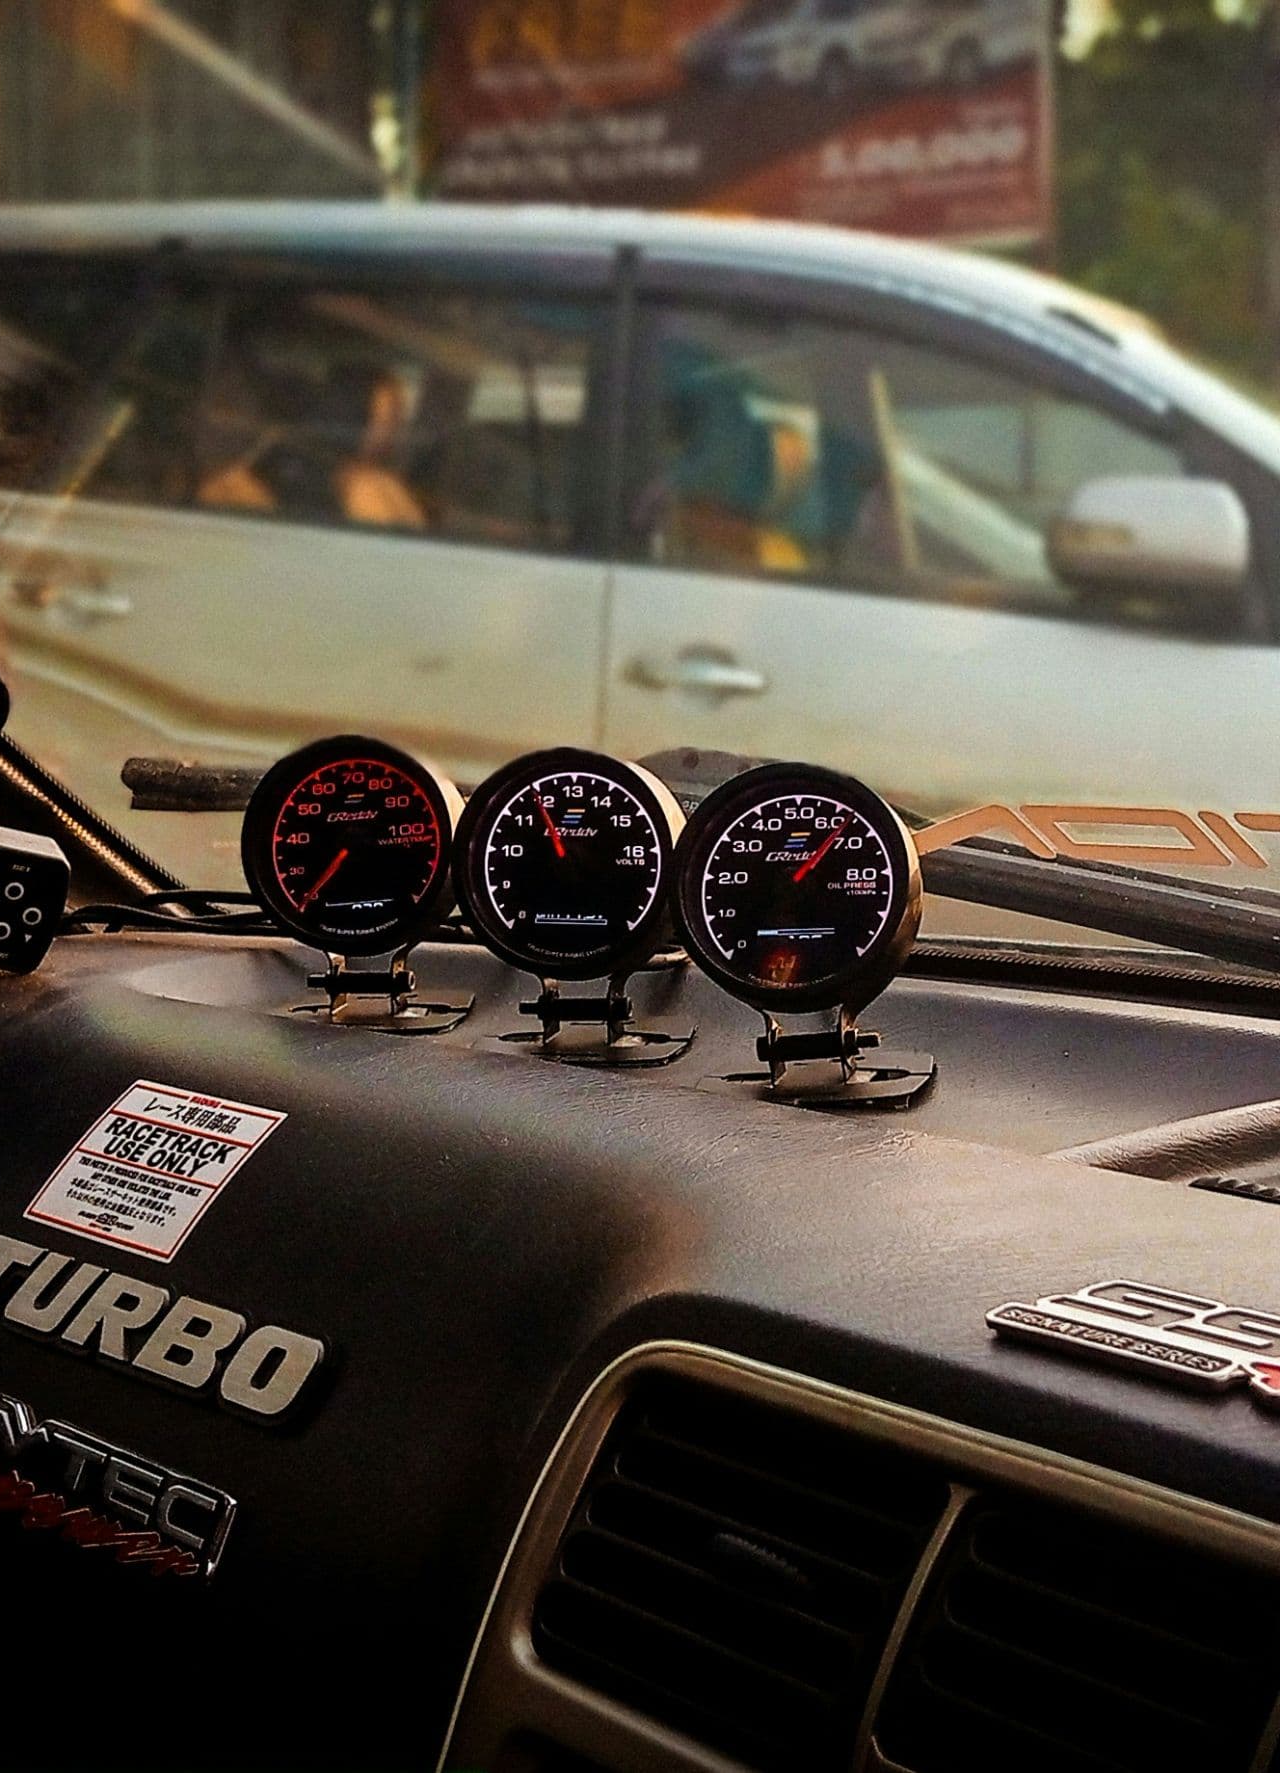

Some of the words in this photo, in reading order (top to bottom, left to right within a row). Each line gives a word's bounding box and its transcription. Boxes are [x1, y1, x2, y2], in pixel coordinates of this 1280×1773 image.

[342, 772, 364, 784] 70
[368, 778, 392, 790] 80
[312, 783, 336, 795] 60
[562, 786, 583, 798] 13
[385, 796, 410, 808] 90
[590, 796, 612, 808] 14
[297, 803, 321, 816] 50
[784, 807, 814, 819] 5.0
[514, 815, 533, 826] 11
[610, 815, 631, 827] 15
[752, 818, 782, 831] 4.0
[815, 817, 845, 829] 6.0
[388, 824, 425, 836] 100
[286, 832, 310, 845] 40
[833, 837, 863, 849] 7.0
[501, 845, 523, 857] 10
[623, 846, 644, 858] 16
[732, 840, 763, 853] 3.0
[289, 866, 305, 875] 30
[846, 868, 877, 881] 8.0
[718, 872, 748, 884] 2.0
[503, 880, 511, 889] 9
[827, 882, 842, 890] OIL
[843, 881, 876, 889] PRESS
[719, 908, 736, 918] 1.0
[738, 939, 747, 949] 0
[143, 1097, 241, 1135] レース専用部品
[105, 1117, 239, 1165] RACETRACK
[103, 1136, 146, 1163] USE
[146, 1149, 211, 1178] ONLY
[1003, 1308, 1131, 1349] SIGNATURE
[1131, 1340, 1222, 1373] SERIES
